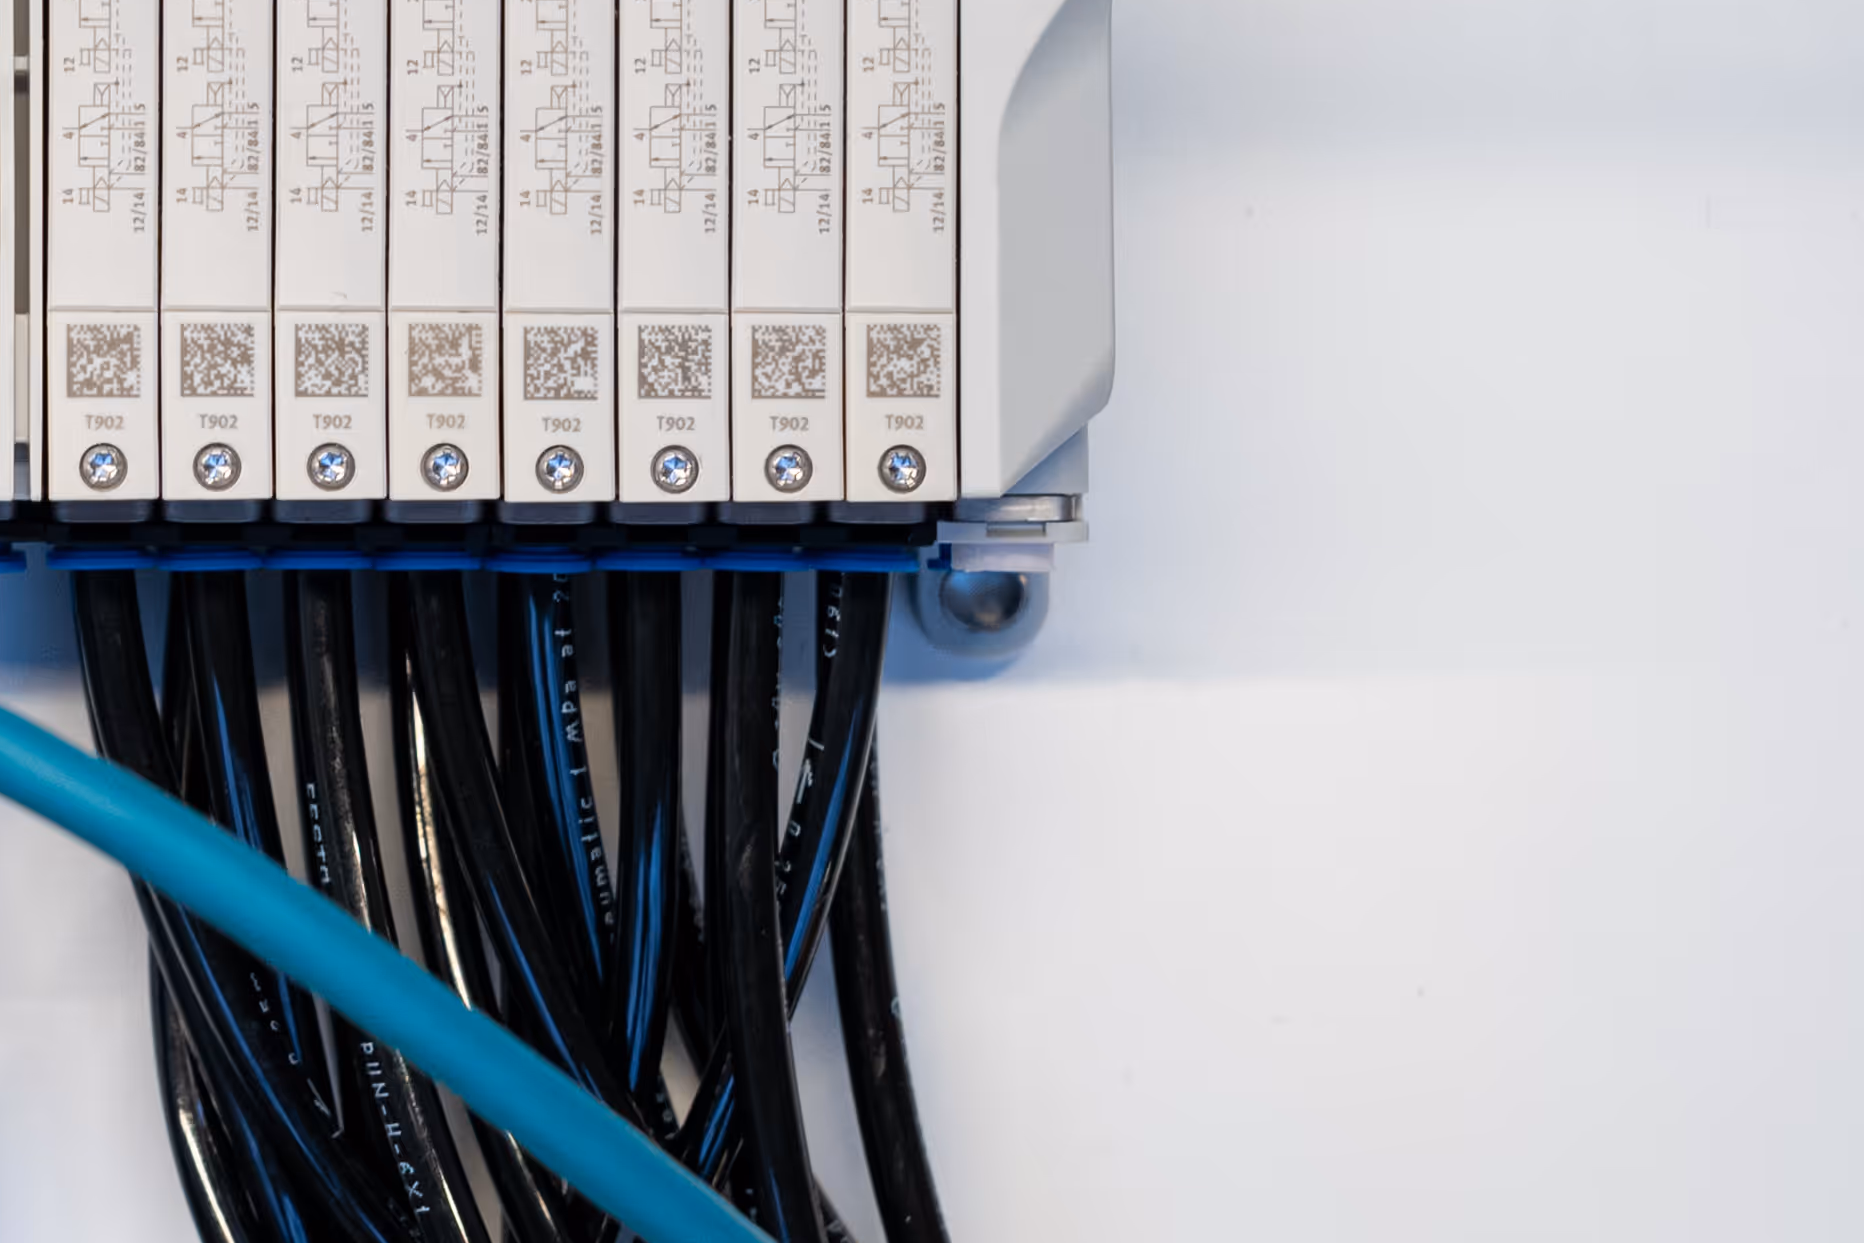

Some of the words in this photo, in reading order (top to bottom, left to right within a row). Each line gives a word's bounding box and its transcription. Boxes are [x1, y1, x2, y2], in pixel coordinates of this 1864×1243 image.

[63, 56, 75, 72] 12
[176, 55, 188, 71] 12
[291, 56, 303, 72] 12
[406, 58, 418, 74] 12
[520, 58, 532, 74] 12
[634, 57, 646, 73] 12
[748, 57, 760, 73] 12
[862, 56, 874, 72] 12
[62, 188, 74, 204] 14
[176, 187, 188, 203] 14
[290, 188, 302, 204] 14
[405, 190, 417, 206] 14
[519, 190, 531, 206] 14
[633, 189, 645, 205] 14
[747, 189, 759, 205] 14
[862, 188, 874, 204] 14
[133, 192, 147, 233] 12/14
[247, 191, 261, 232] 12/14
[361, 192, 375, 232] 12/14
[476, 194, 490, 236] 12/14
[590, 194, 604, 236] 12/14
[704, 193, 718, 234] 12/14
[818, 193, 832, 234] 12/14
[932, 192, 946, 233] 12/14
[85, 414, 124, 430] T902
[199, 413, 238, 429] T902
[313, 414, 352, 430] T902
[426, 413, 466, 429] T902
[542, 416, 581, 432] T902
[656, 415, 695, 431] T902
[770, 415, 809, 431] T902
[885, 414, 924, 430] T902
